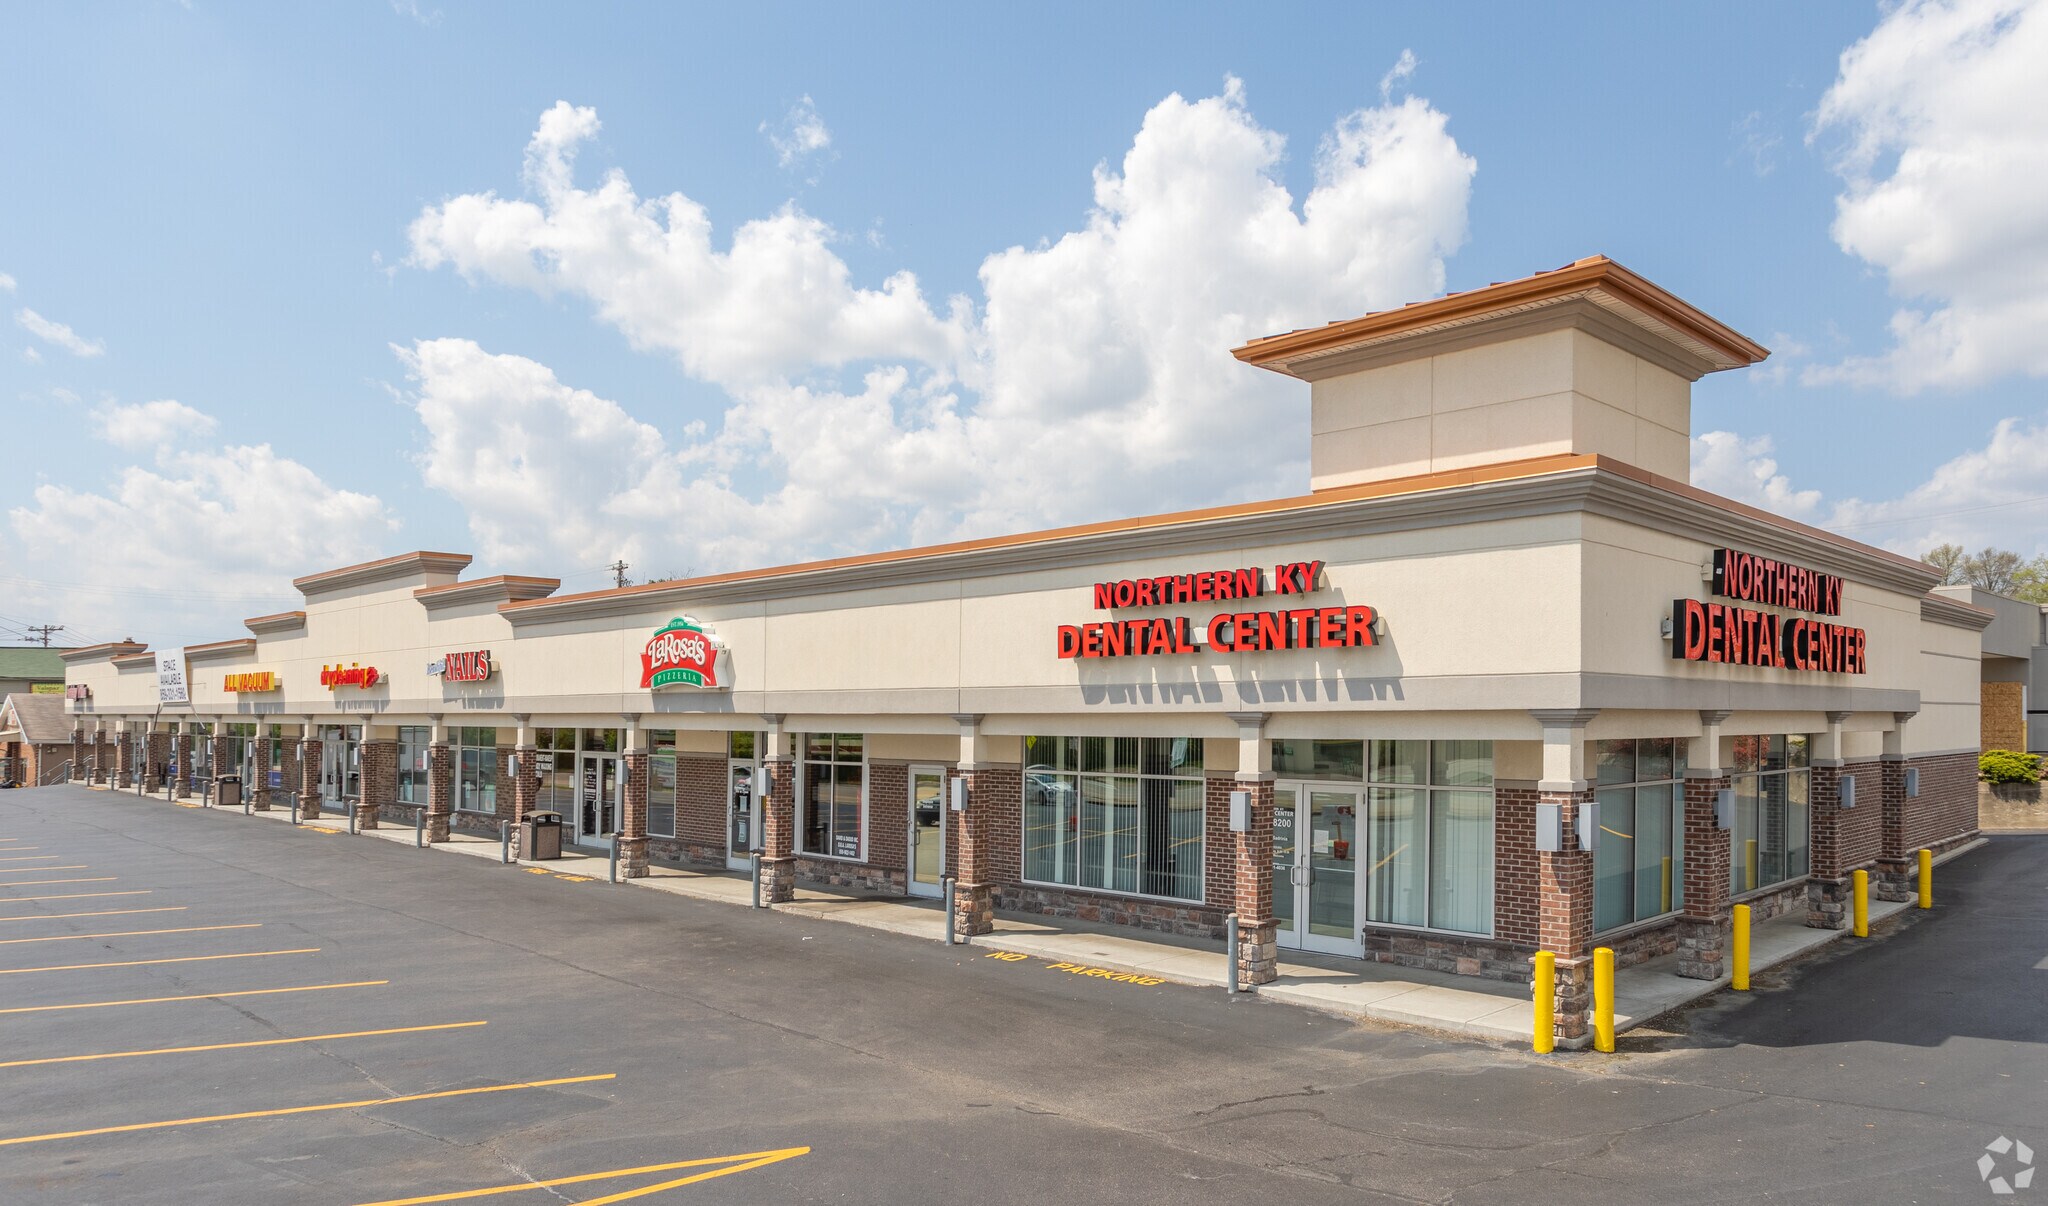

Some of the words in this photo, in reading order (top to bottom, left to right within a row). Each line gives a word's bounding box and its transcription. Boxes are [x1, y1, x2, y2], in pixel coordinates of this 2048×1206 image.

[1093, 566, 1259, 610] NORTHERN
[1275, 560, 1322, 595] KY
[1722, 548, 1819, 612] NORTHERN
[1825, 575, 1845, 616] KY
[1057, 616, 1196, 659] DENTAL
[1207, 605, 1379, 653] CENTER
[1683, 598, 1786, 668] DENTAL
[1792, 618, 1867, 674] CENTER
[163, 659, 176, 672] SPACE
[445, 649, 488, 681] NAILS
[647, 633, 706, 670] LaRosa's
[160, 672, 182, 685] AVAILABLE
[224, 674, 237, 692] ALL
[238, 671, 270, 692] VACUUM
[657, 671, 697, 683] PIZZERIA
[1273, 818, 1292, 828] 8200
[984, 951, 1029, 962] NO
[1046, 962, 1167, 986] PARKING
